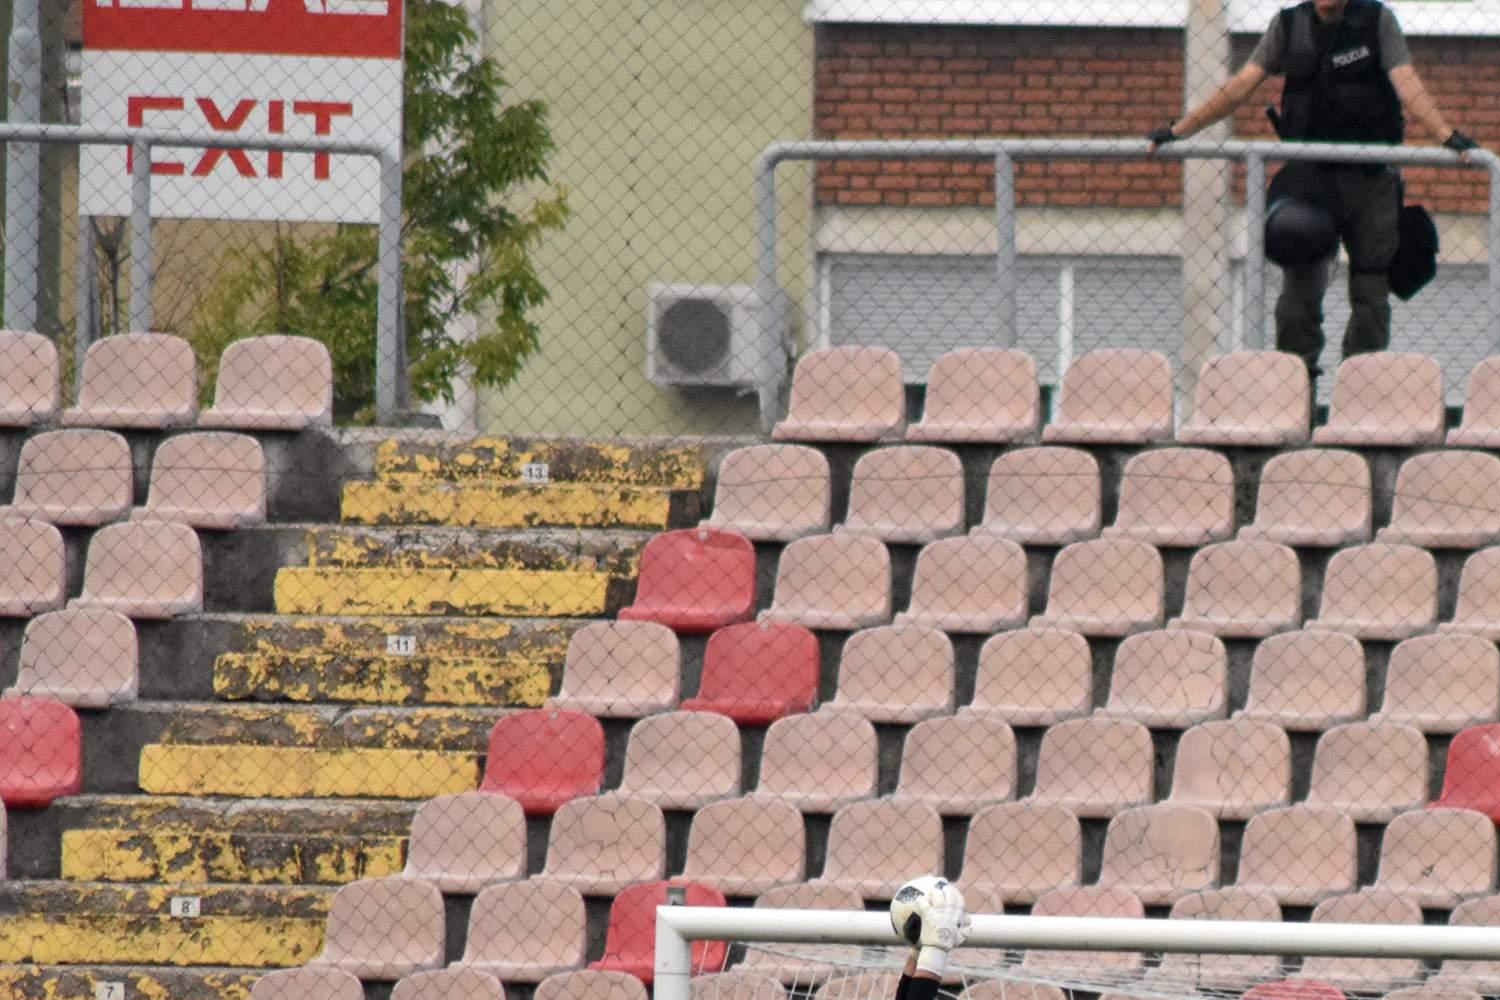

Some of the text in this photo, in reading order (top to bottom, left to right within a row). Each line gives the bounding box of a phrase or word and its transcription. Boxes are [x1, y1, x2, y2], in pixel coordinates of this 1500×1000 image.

[126, 96, 353, 180] EXIT
[528, 467, 543, 479] 13
[395, 639, 409, 651] 11
